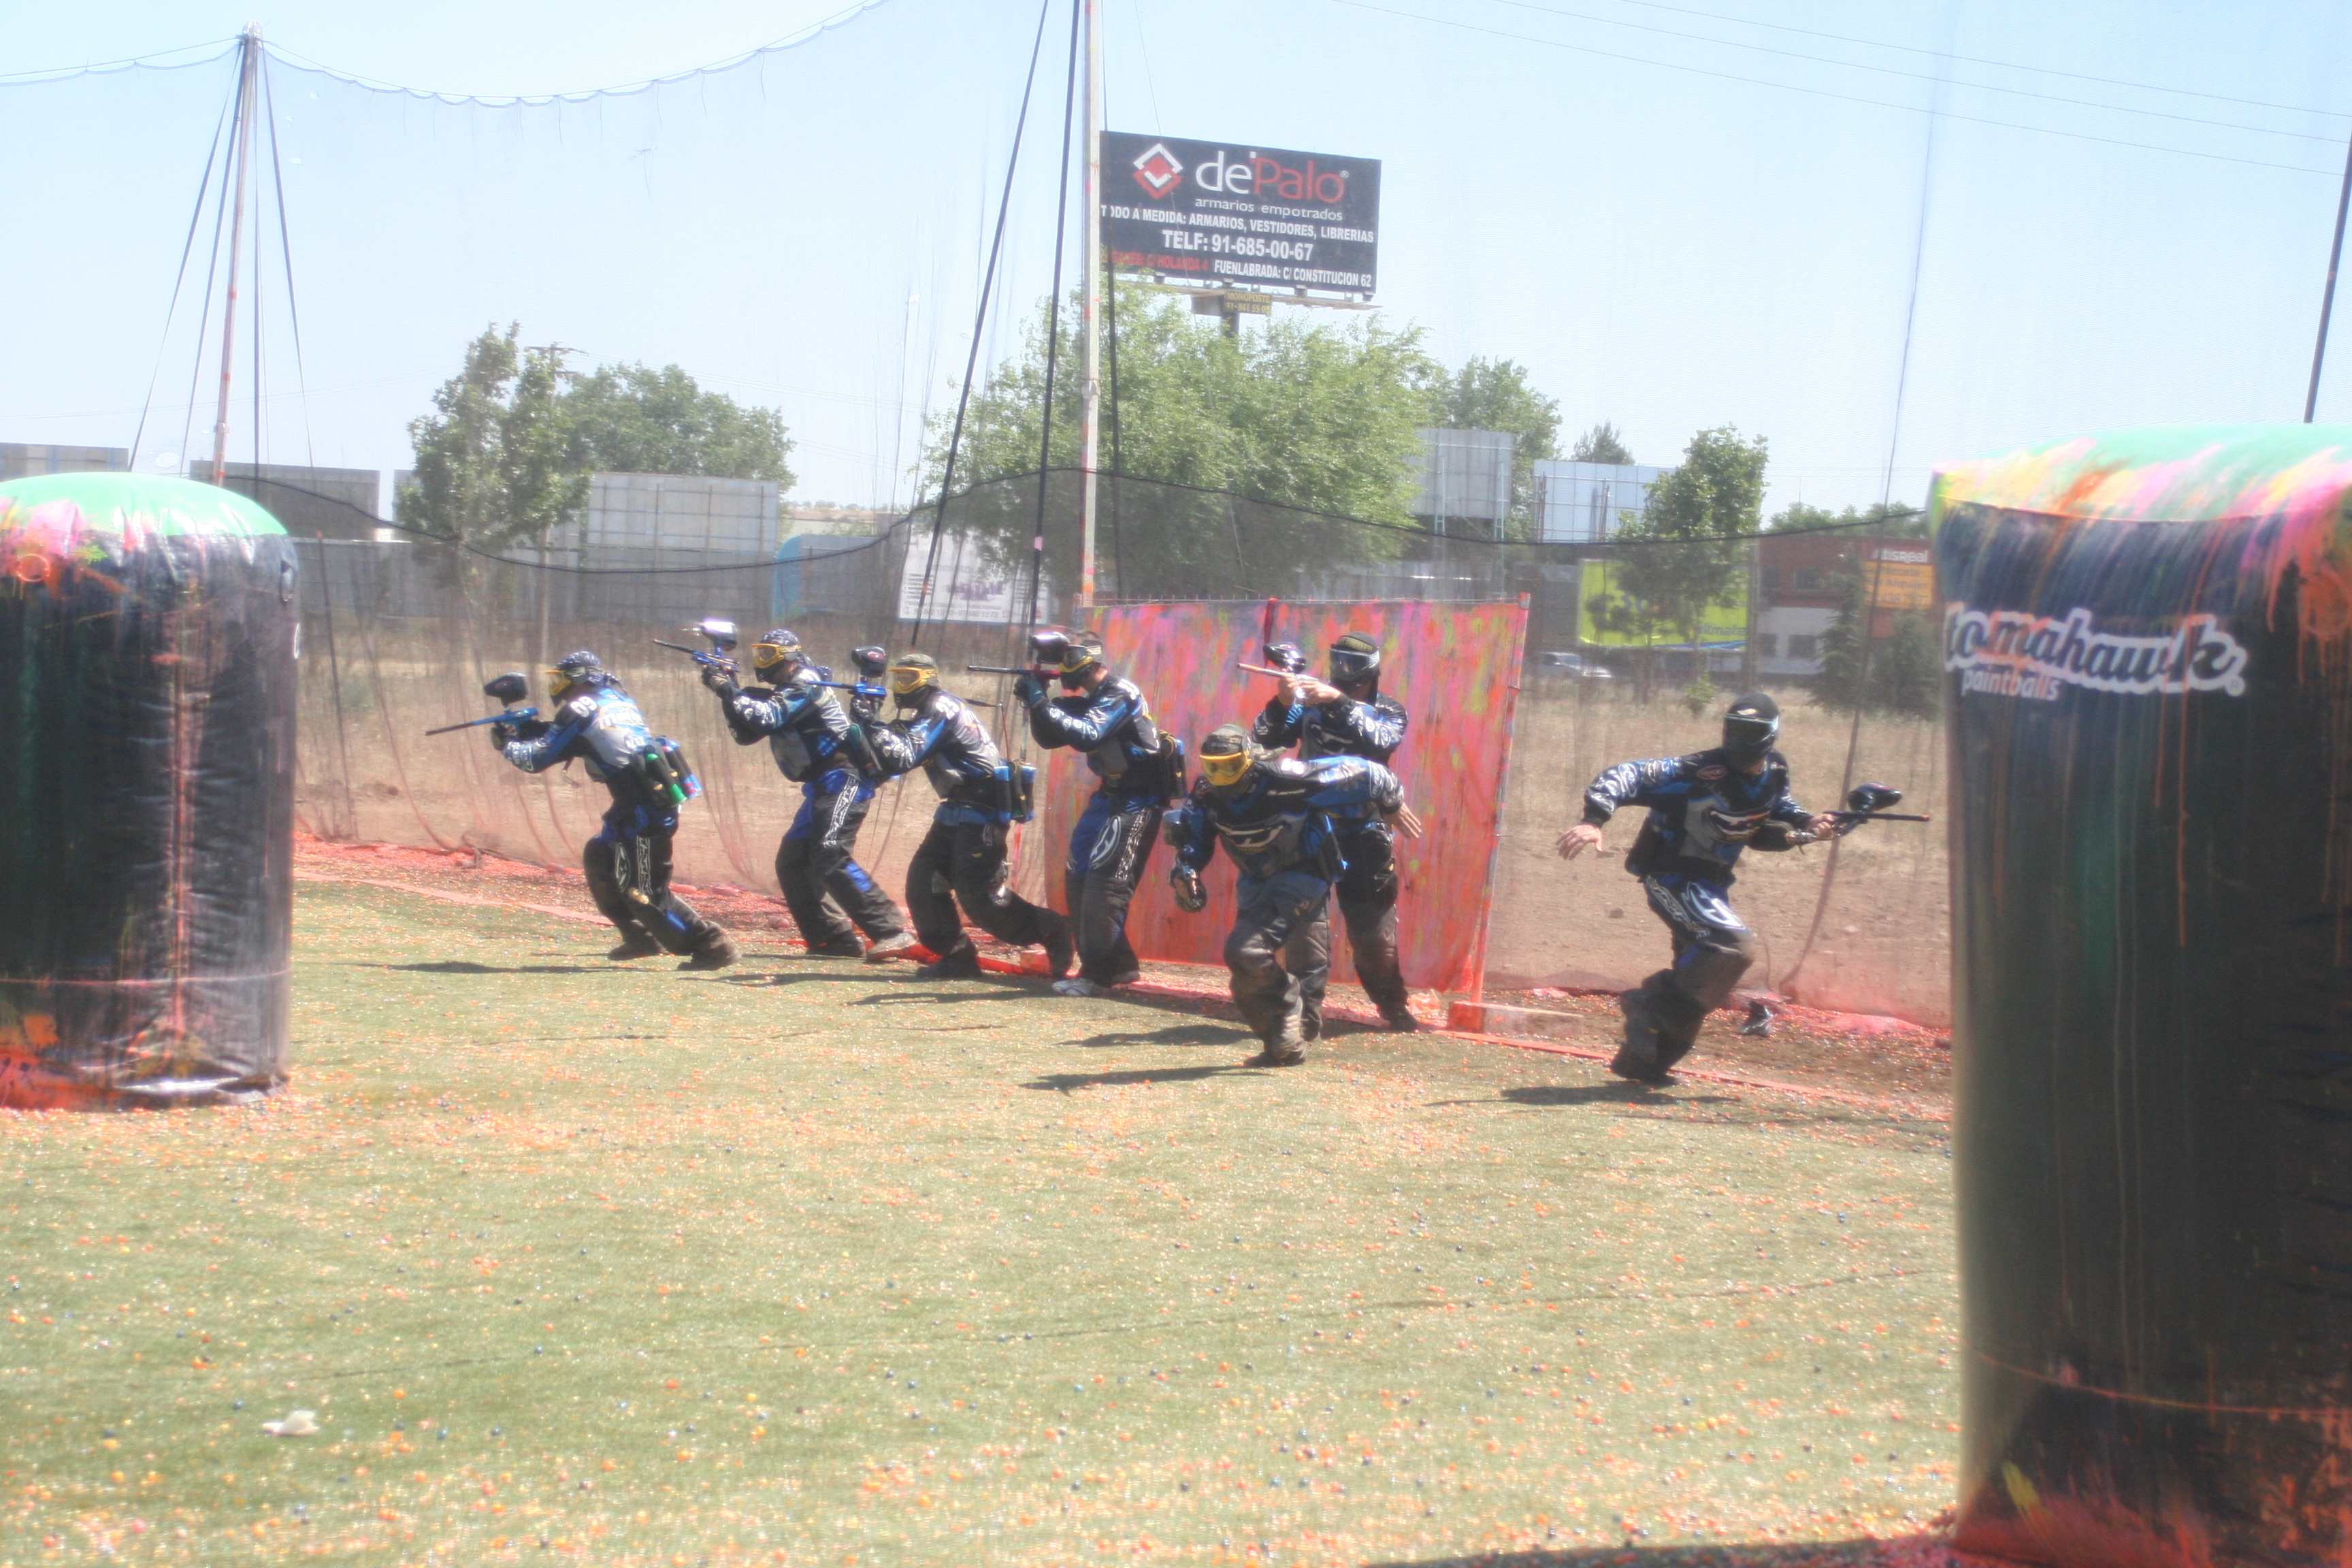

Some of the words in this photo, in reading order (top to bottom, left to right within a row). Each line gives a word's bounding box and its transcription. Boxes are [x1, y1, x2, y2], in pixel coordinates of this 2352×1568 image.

[1195, 198, 1254, 212] armarios
[1261, 205, 1343, 221] empotrados
[1132, 208, 1140, 220] A
[1143, 209, 1186, 224] MEDIDA:
[1189, 212, 1247, 233] ARMARIOS,
[1250, 219, 1316, 240] VESTIDORES,
[1320, 226, 1374, 243] LIBRERIAS
[1162, 229, 1208, 251] TELF:
[1211, 234, 1313, 261] 91-685-00-67
[1214, 259, 1281, 279] FUENLABRADA:
[1294, 267, 1358, 287] CONSTITUCION
[1361, 274, 1372, 287] 62
[1226, 291, 1271, 303] MONOPOSTE
[1961, 664, 2061, 701] paintballs
[570, 696, 598, 718] 09
